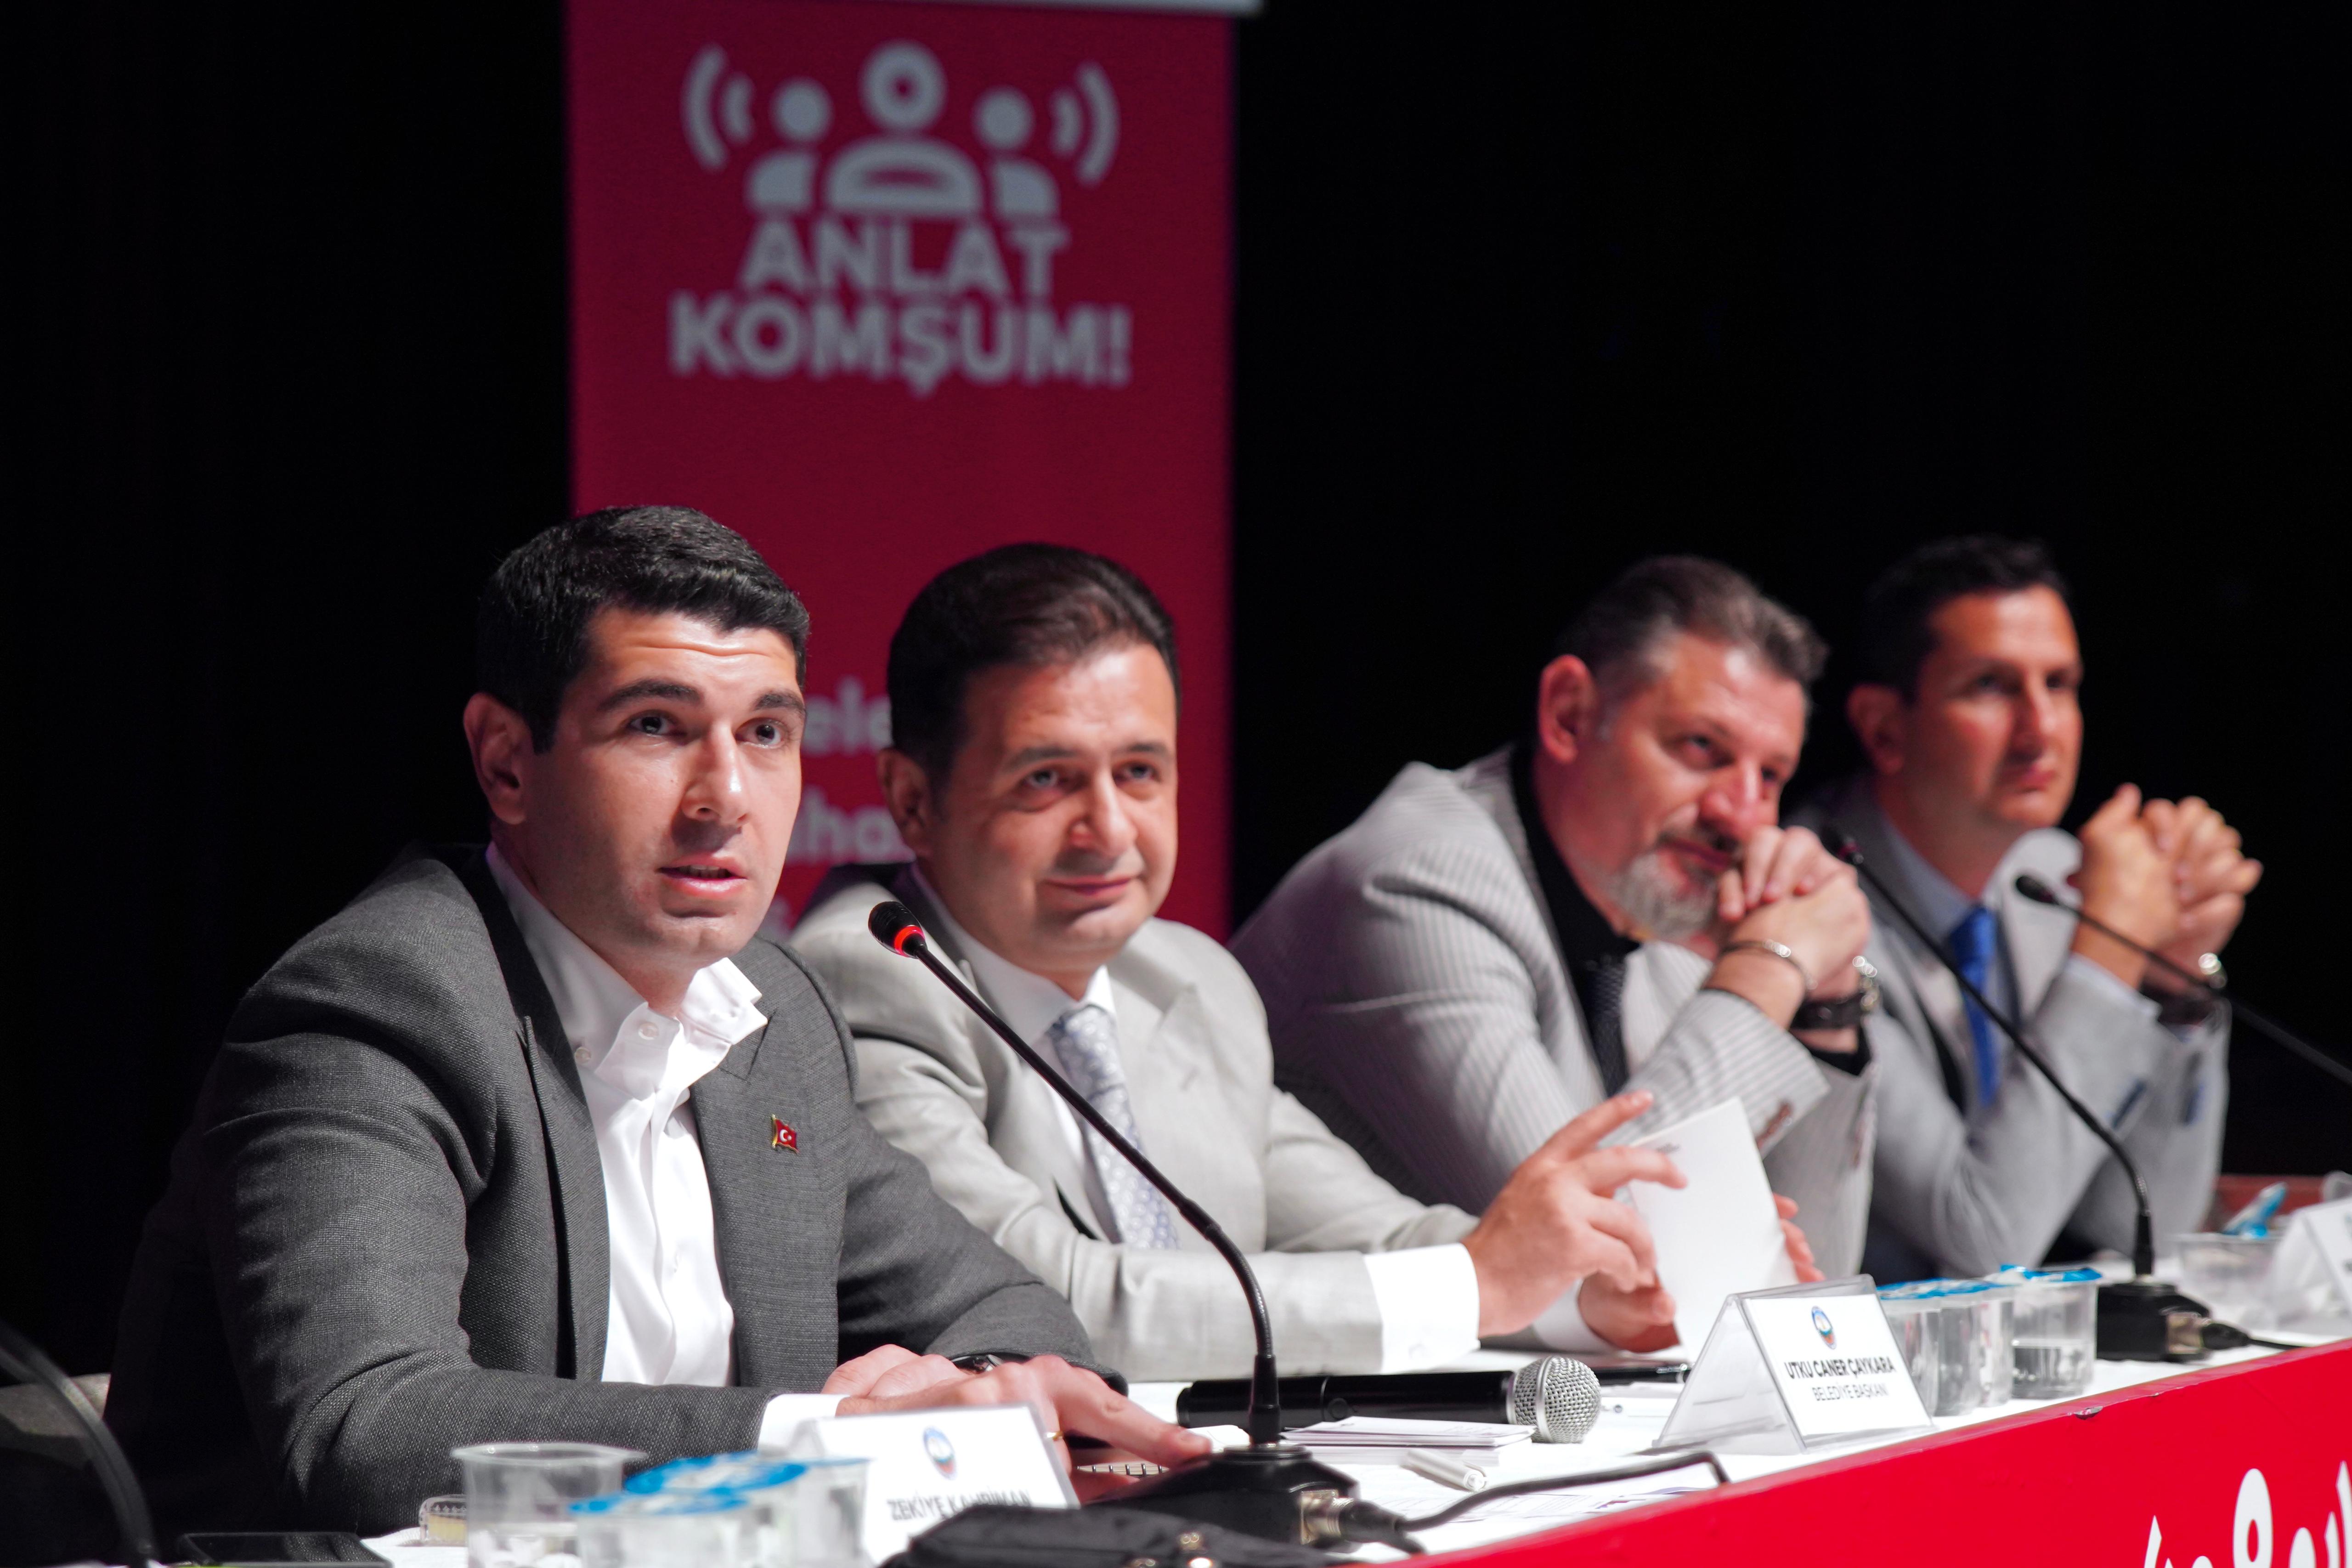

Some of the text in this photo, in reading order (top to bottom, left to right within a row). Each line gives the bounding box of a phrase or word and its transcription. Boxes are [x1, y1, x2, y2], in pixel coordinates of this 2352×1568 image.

[743, 219, 1070, 298] ANLAT
[670, 289, 1132, 395] KOMŞUM!
[1784, 1356, 1897, 1379] UTKU CANER ÇAYKARA
